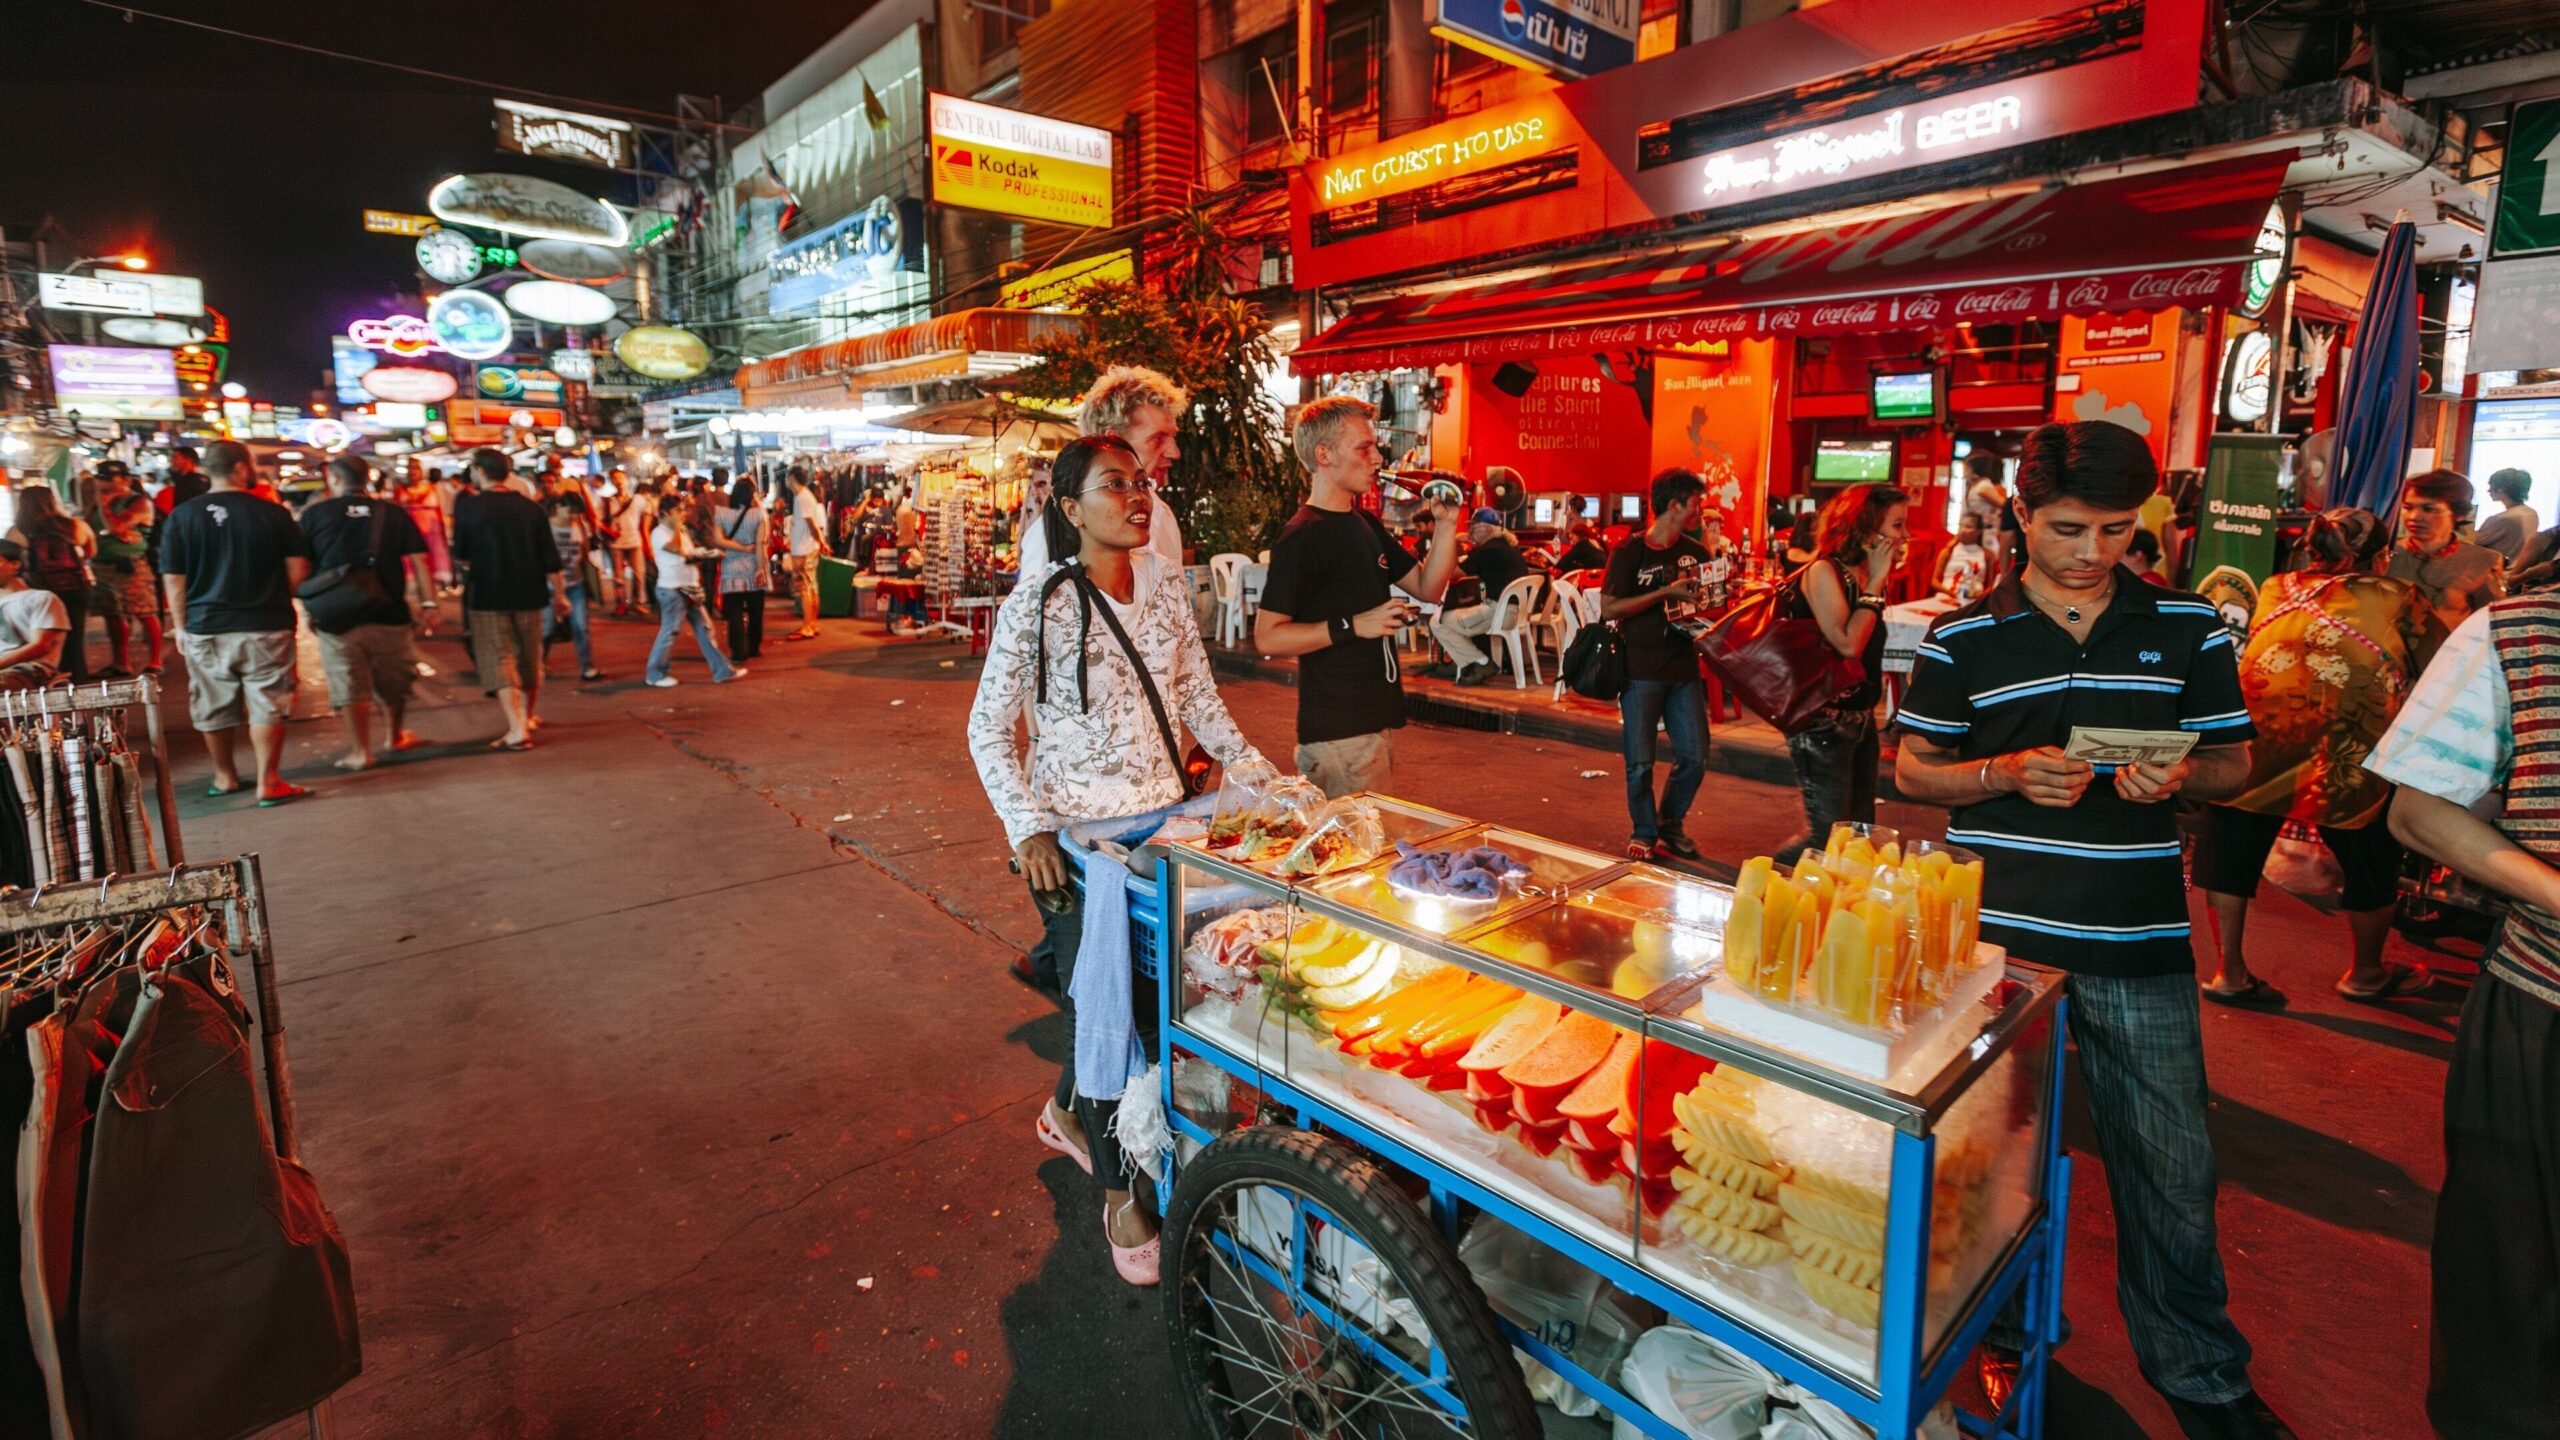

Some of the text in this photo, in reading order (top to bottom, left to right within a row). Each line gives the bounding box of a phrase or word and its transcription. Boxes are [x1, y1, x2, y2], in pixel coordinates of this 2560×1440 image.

[934, 107, 1103, 160] CENTRAL DIGITAL LAB
[1452, 117, 1544, 165] HOUSE
[1771, 110, 1906, 184] Miguel
[1915, 95, 2021, 150] BEER
[978, 154, 1040, 181] Kodak
[1003, 178, 1104, 209] PROFESSIONAL
[1530, 373, 1602, 394] aptures
[1663, 377, 1687, 391] San
[1687, 373, 1725, 390] Miguel
[1519, 394, 1601, 416] the Spirit
[1276, 1231, 1342, 1286] YASA
